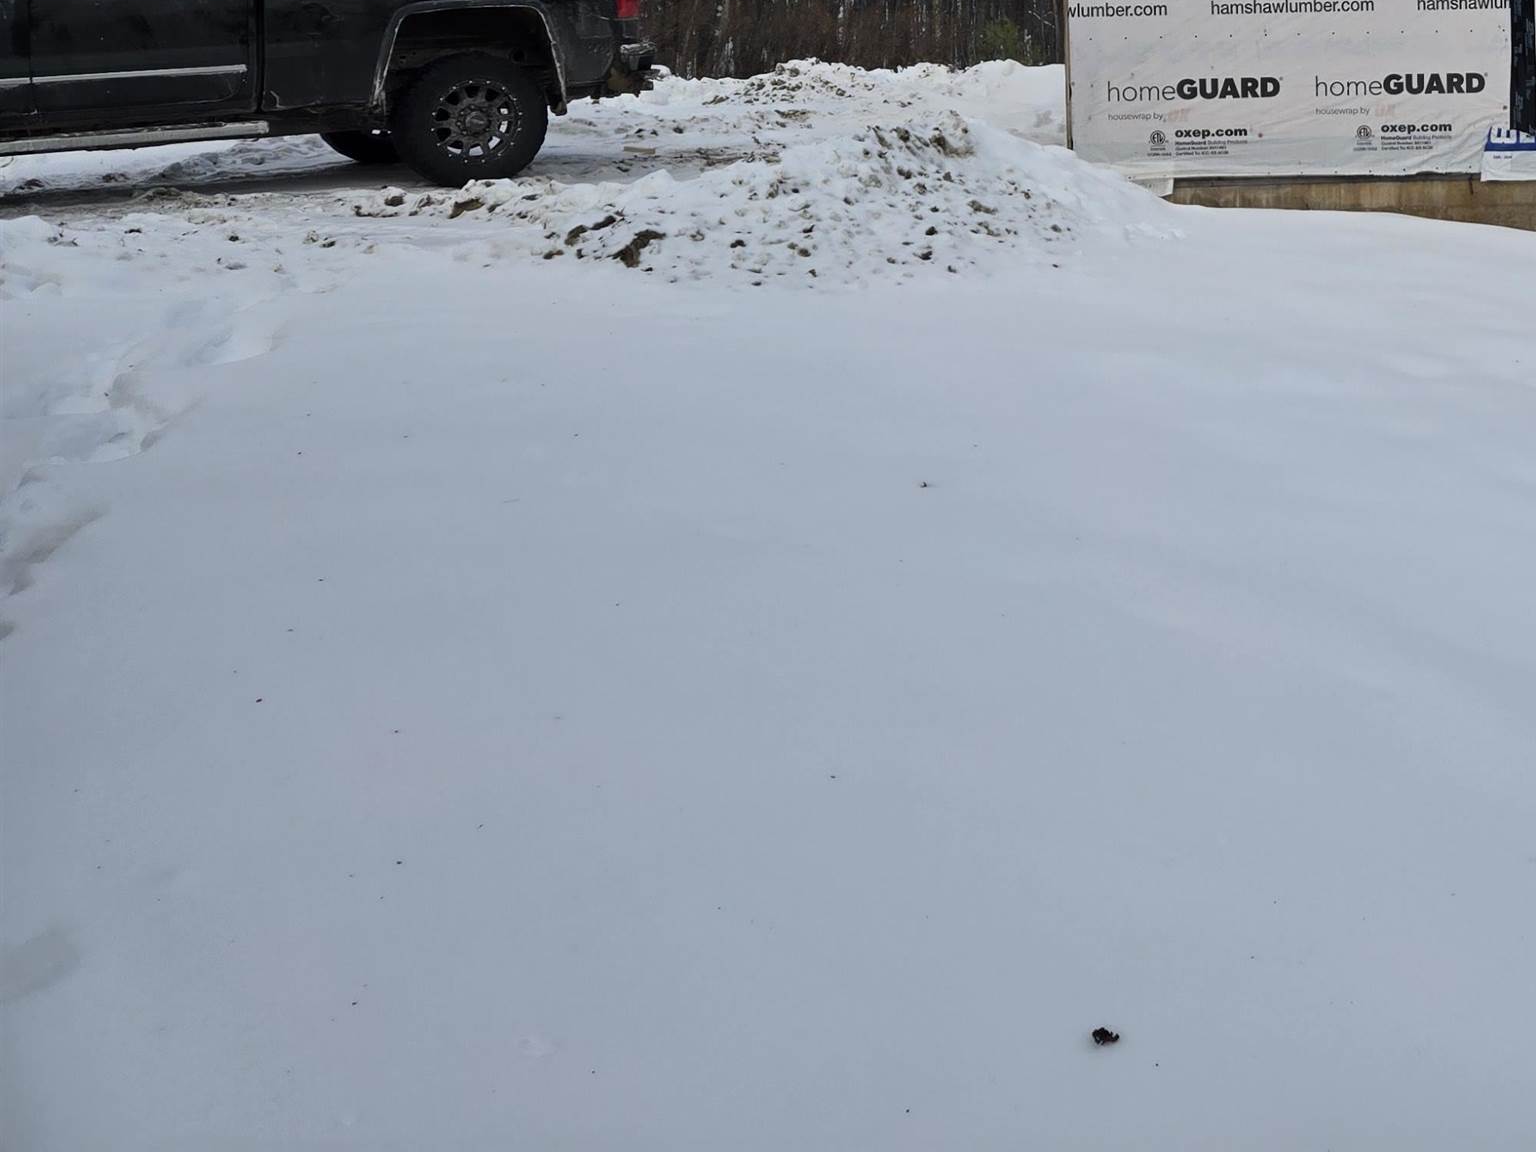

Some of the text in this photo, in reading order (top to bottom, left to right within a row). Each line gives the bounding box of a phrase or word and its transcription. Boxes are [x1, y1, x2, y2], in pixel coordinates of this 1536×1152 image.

[1107, 77, 1281, 101] homeGUARD
[1315, 73, 1486, 96] homeGUARD
[1315, 107, 1359, 116] housewrap
[1360, 106, 1370, 116] by
[1108, 113, 1151, 121] housewrap
[1153, 112, 1163, 122] by
[1175, 127, 1248, 139] oxep.com
[1381, 123, 1452, 134] oxep.com
